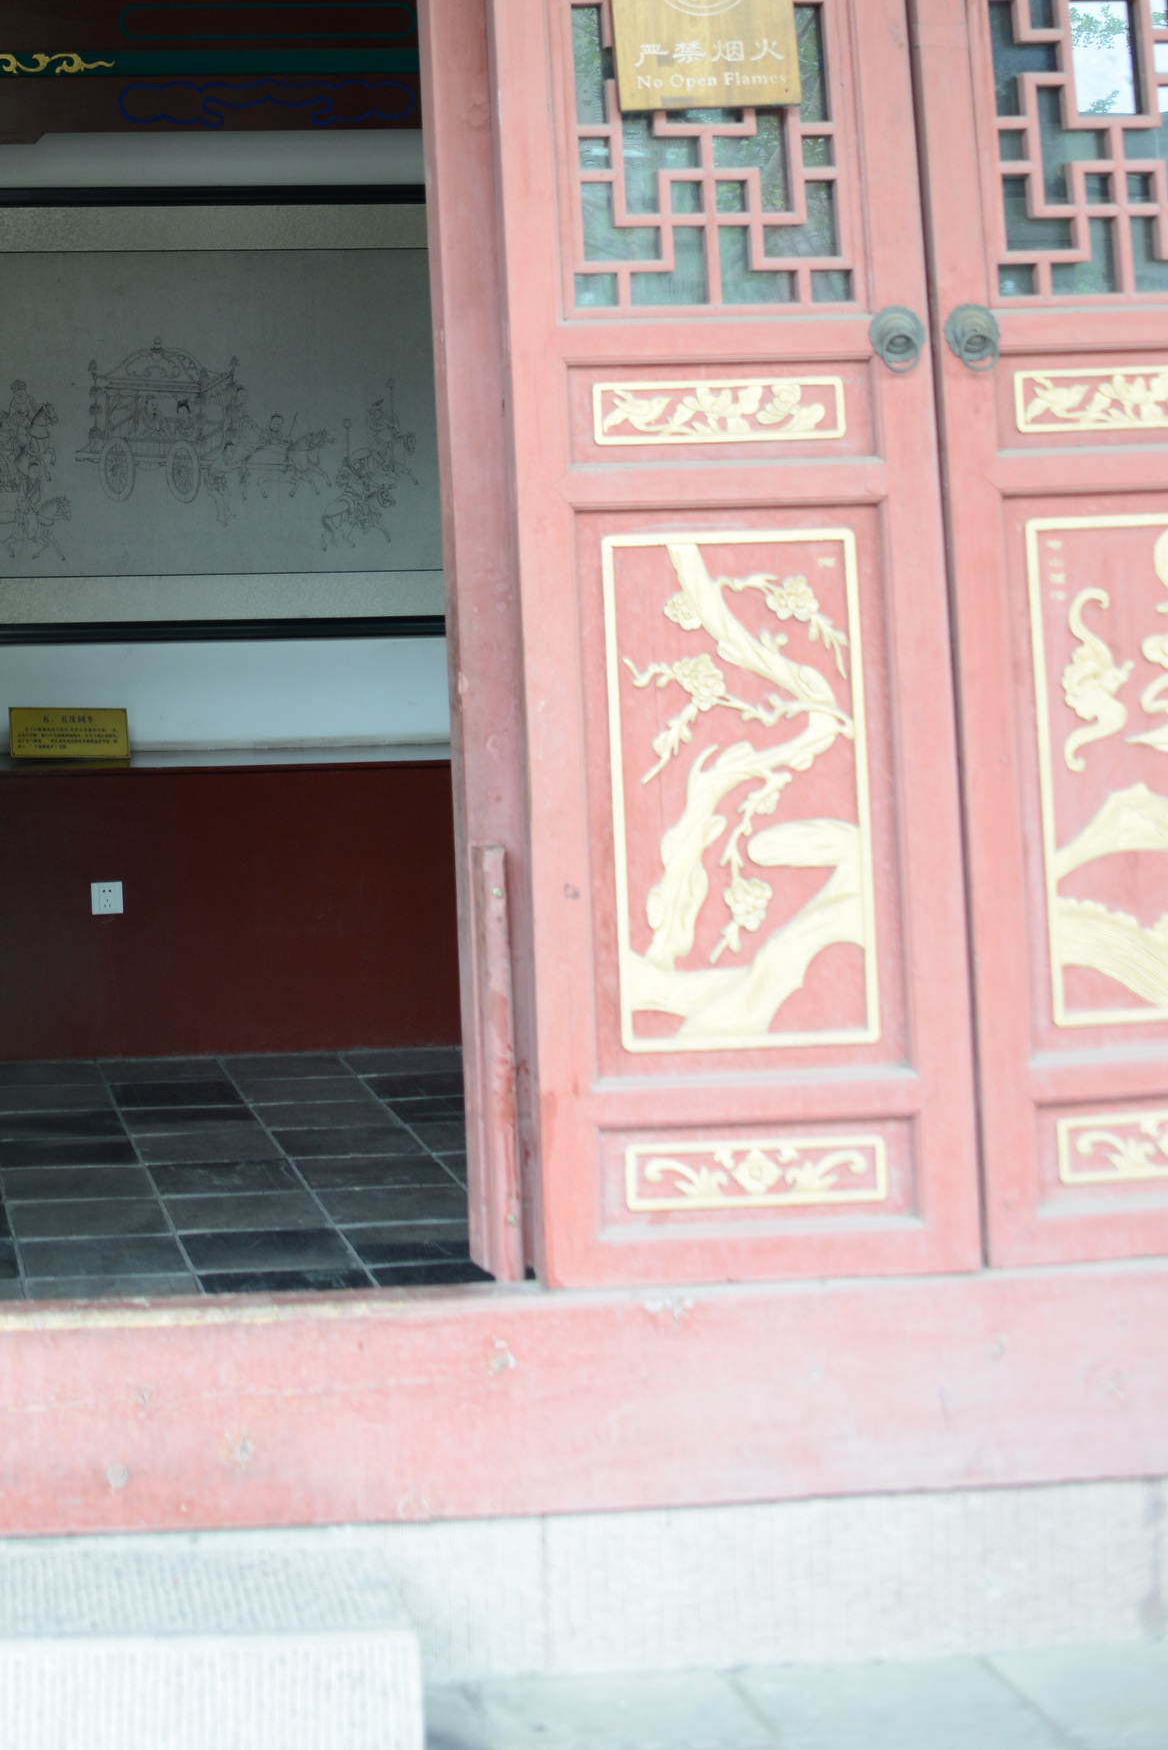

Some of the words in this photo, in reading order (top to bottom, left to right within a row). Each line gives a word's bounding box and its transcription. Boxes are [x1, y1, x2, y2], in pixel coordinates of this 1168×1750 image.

[634, 39, 785, 67] 严禁烟火
[636, 75, 663, 90] No
[670, 74, 717, 91] Open
[724, 72, 786, 87] Flames
